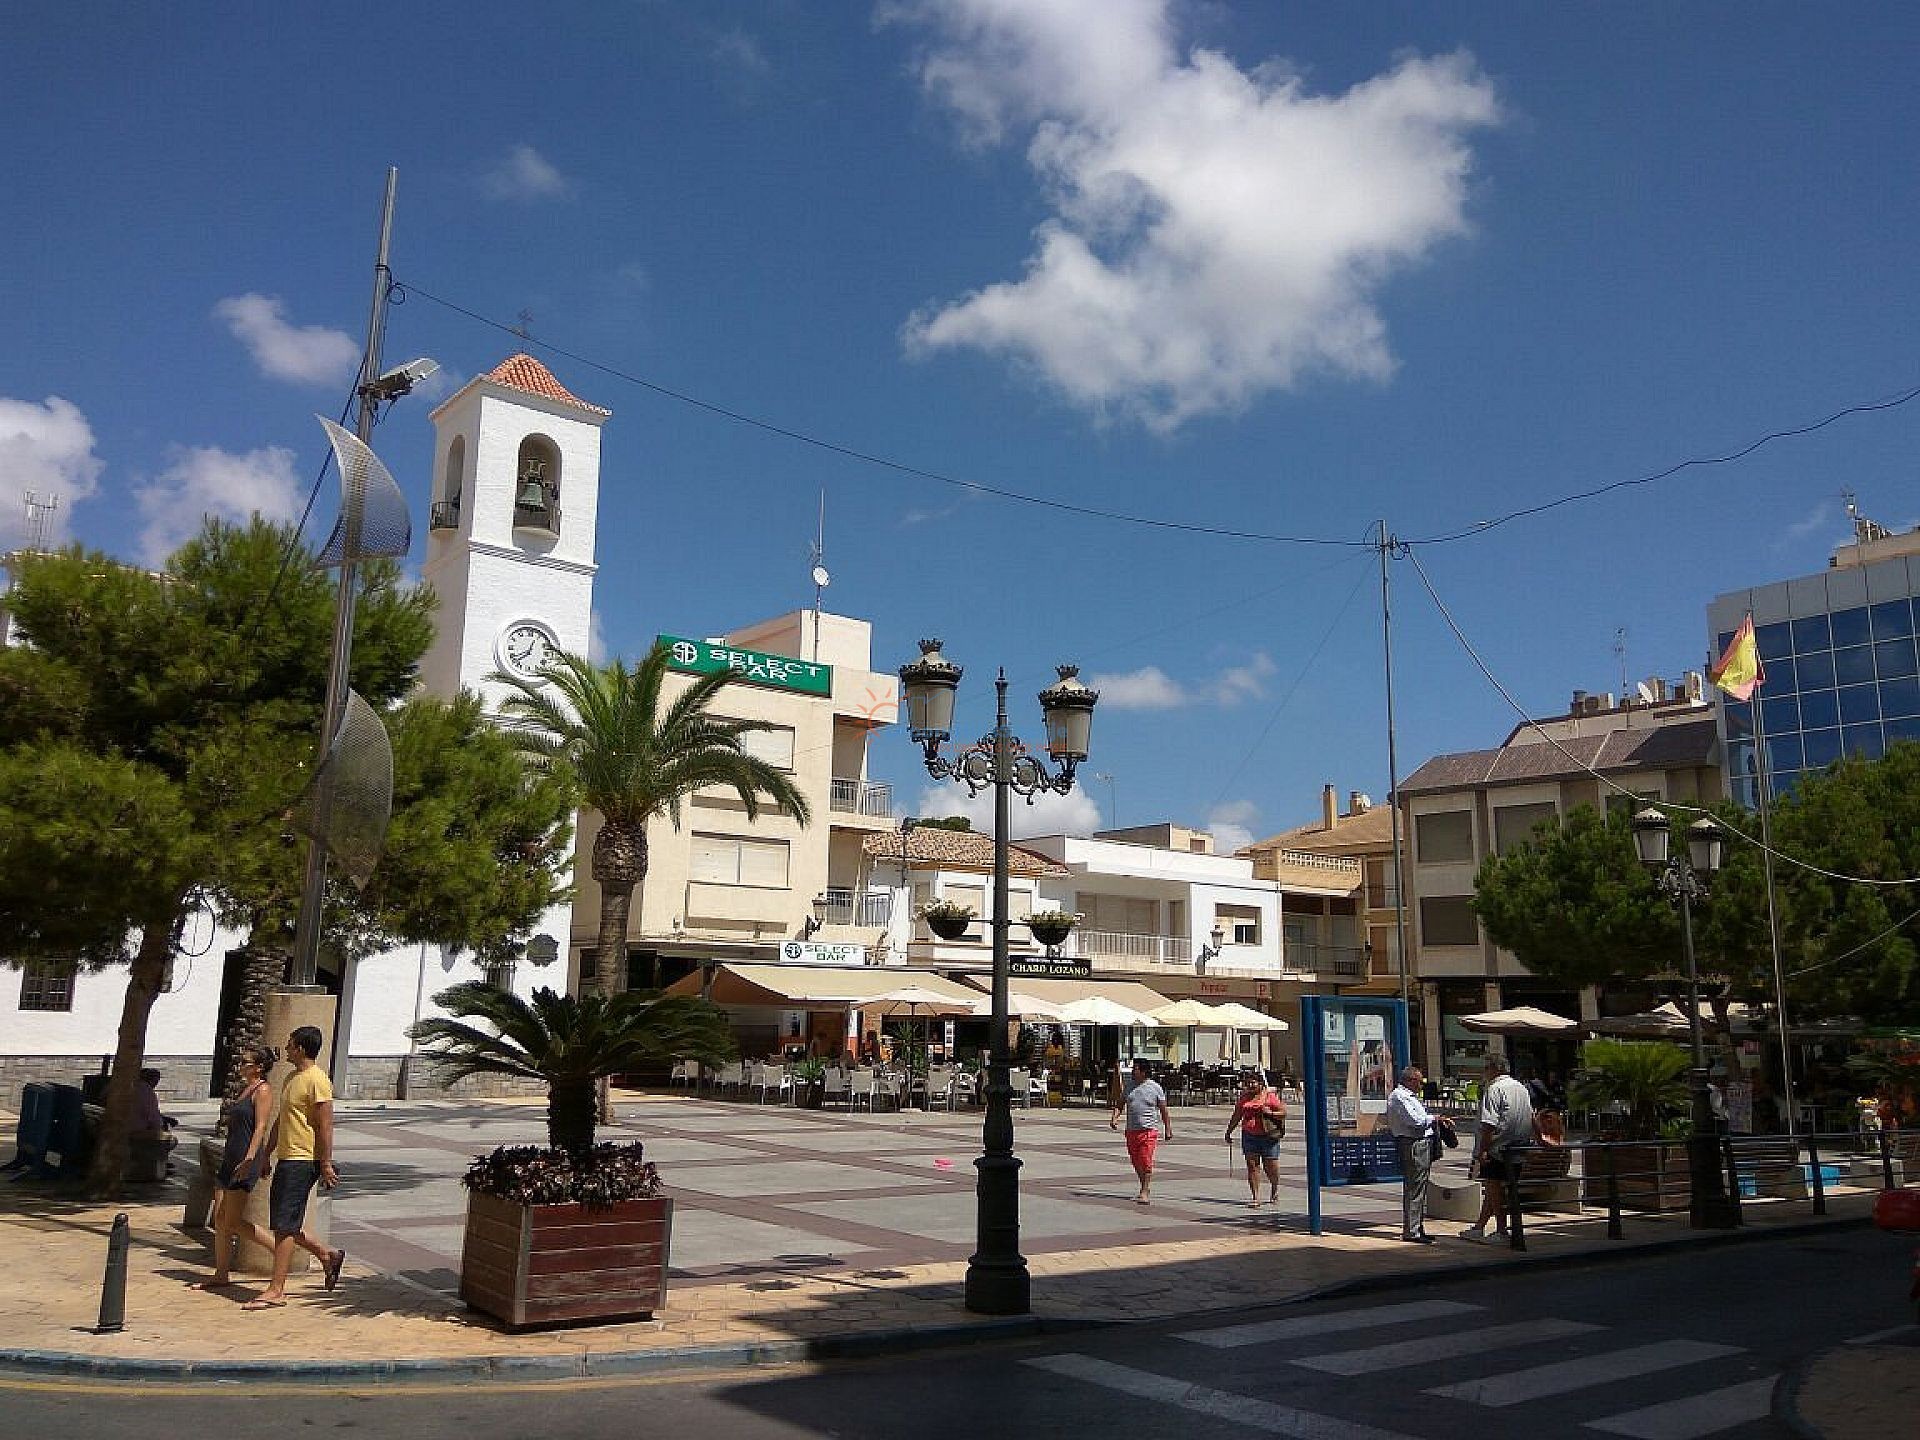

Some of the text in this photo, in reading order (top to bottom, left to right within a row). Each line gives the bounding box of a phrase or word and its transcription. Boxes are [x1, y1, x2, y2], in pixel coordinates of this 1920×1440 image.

[710, 650, 822, 678] SELECT
[730, 661, 788, 682] BAR
[804, 944, 859, 954] SELECT
[1049, 966, 1089, 976] LOZANO
